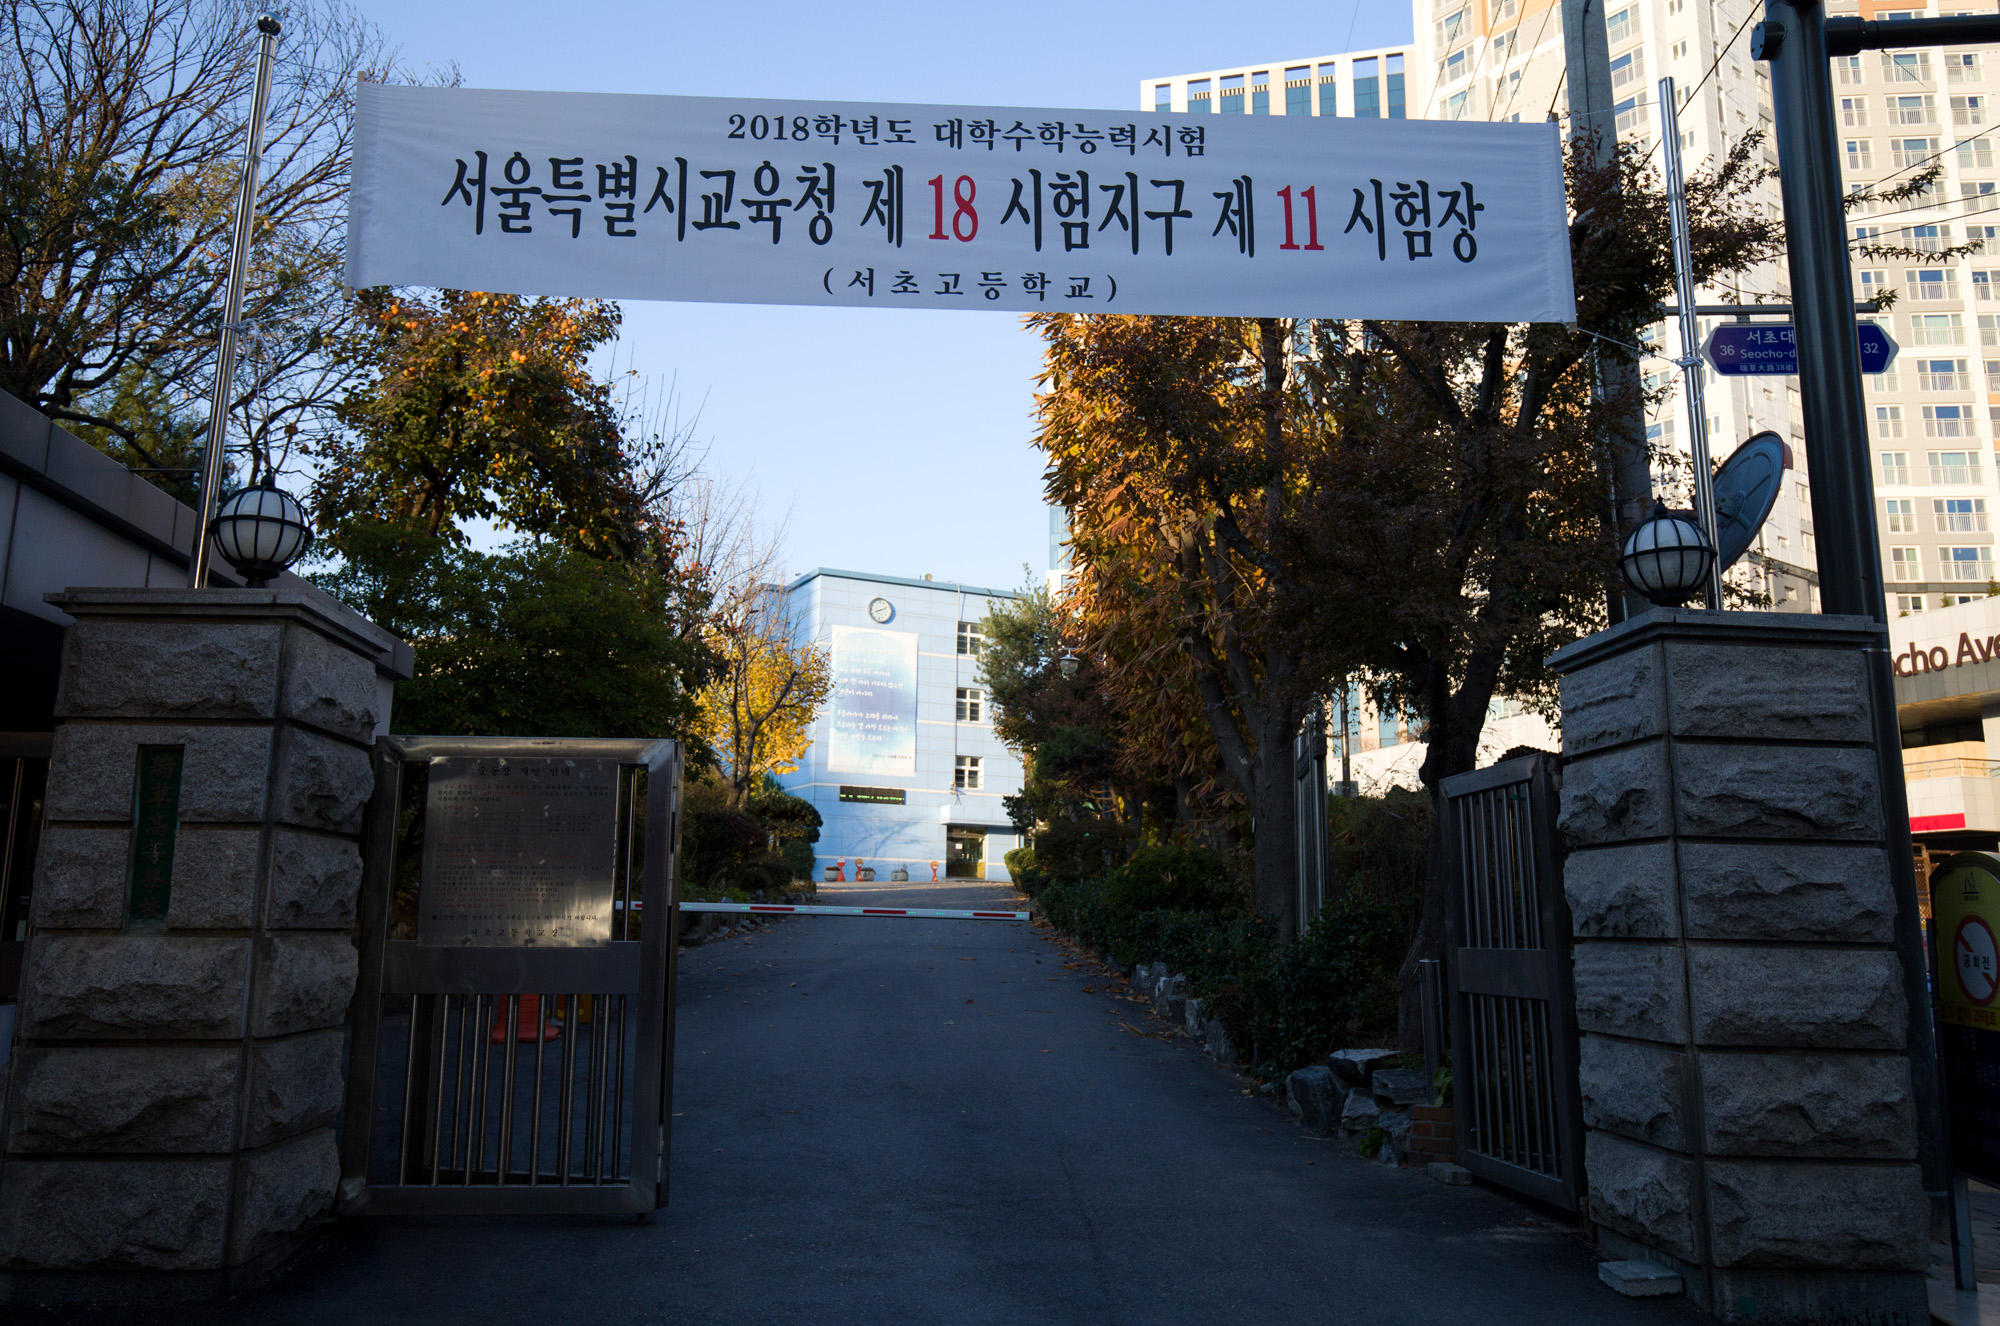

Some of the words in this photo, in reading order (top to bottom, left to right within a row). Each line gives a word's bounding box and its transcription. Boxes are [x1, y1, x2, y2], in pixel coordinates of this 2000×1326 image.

[727, 114, 916, 146] 2018학년도
[933, 118, 1205, 157] 대학수학능력시험
[441, 150, 839, 246] 서울특별시교육청
[860, 164, 904, 248] 제
[928, 174, 979, 243] 18
[1000, 168, 1193, 257] 시험지구
[1212, 174, 1255, 258] 제
[1276, 184, 1325, 251] 11
[1343, 178, 1485, 264] 시험장
[1719, 345, 1735, 356] 36
[1863, 343, 1879, 354] 32
[1892, 642, 1949, 677] cho
[1961, 953, 1991, 970] 공회전
